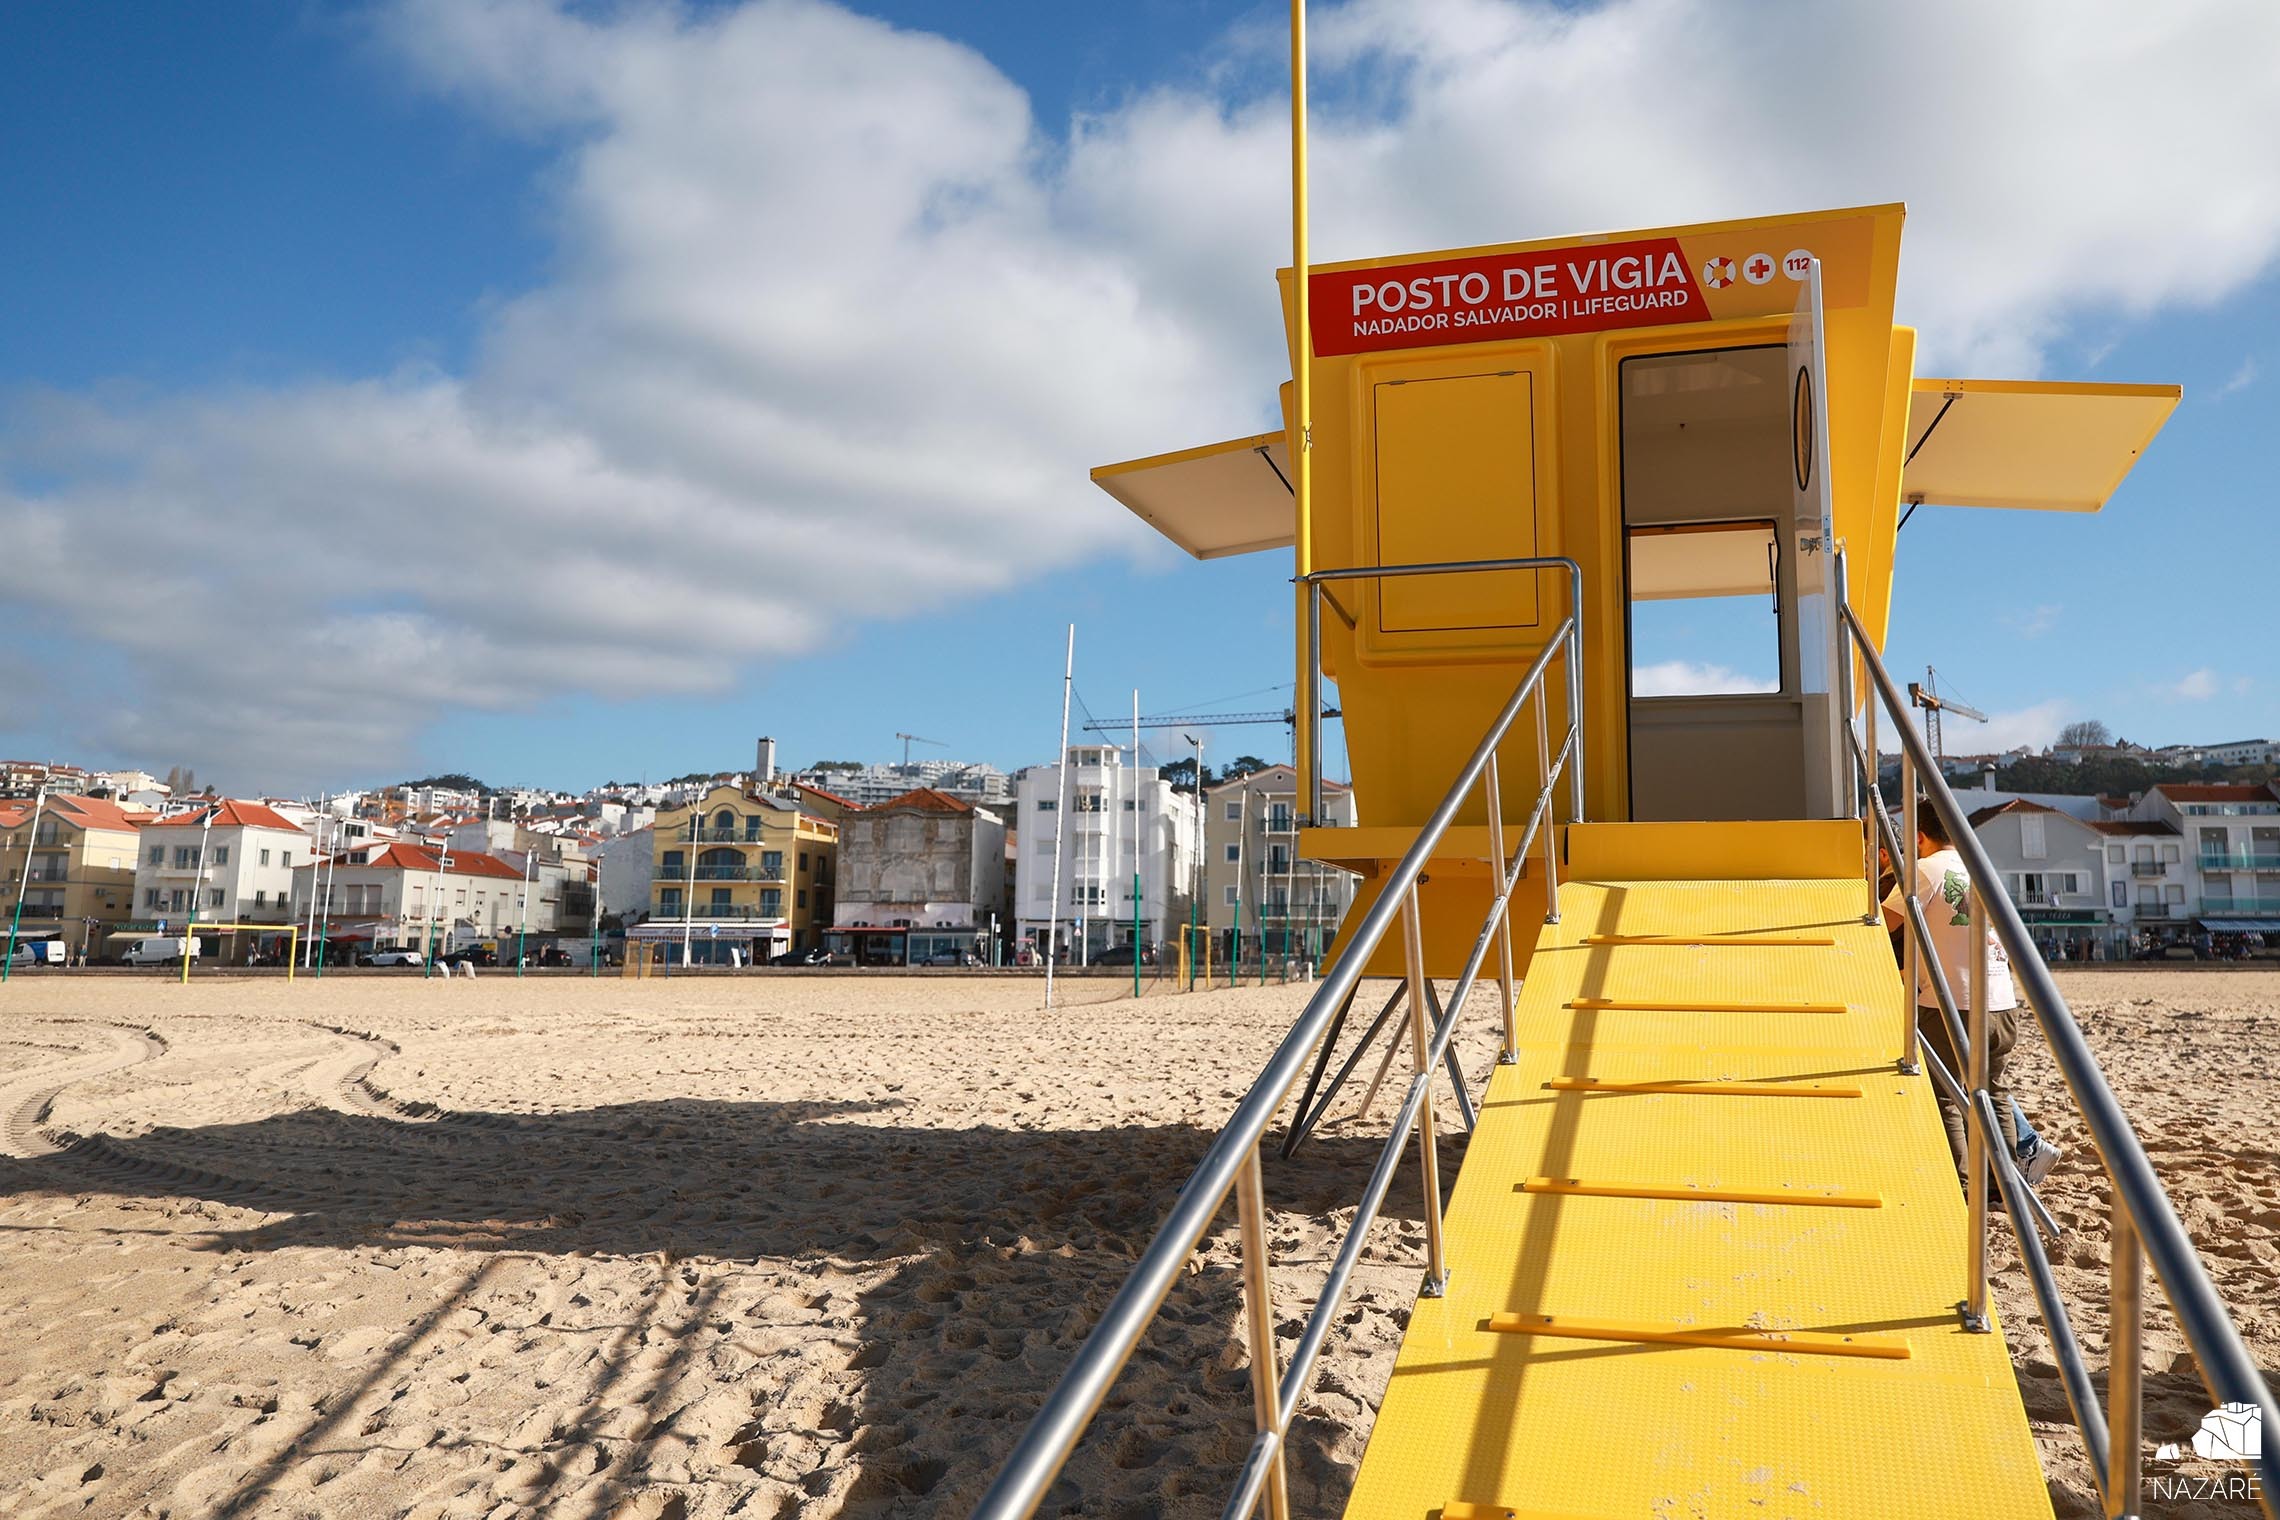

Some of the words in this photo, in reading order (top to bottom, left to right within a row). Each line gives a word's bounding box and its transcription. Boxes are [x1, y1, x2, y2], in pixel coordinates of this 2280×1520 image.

[1352, 272, 1490, 316] POSTO
[1503, 264, 1558, 301] DE
[1567, 252, 1687, 294] VIGIA
[1786, 257, 1810, 271] 112
[1353, 313, 1449, 337] NADADOR
[1453, 302, 1557, 327] SALVADOR
[1573, 290, 1688, 316] LIFEGUARD
